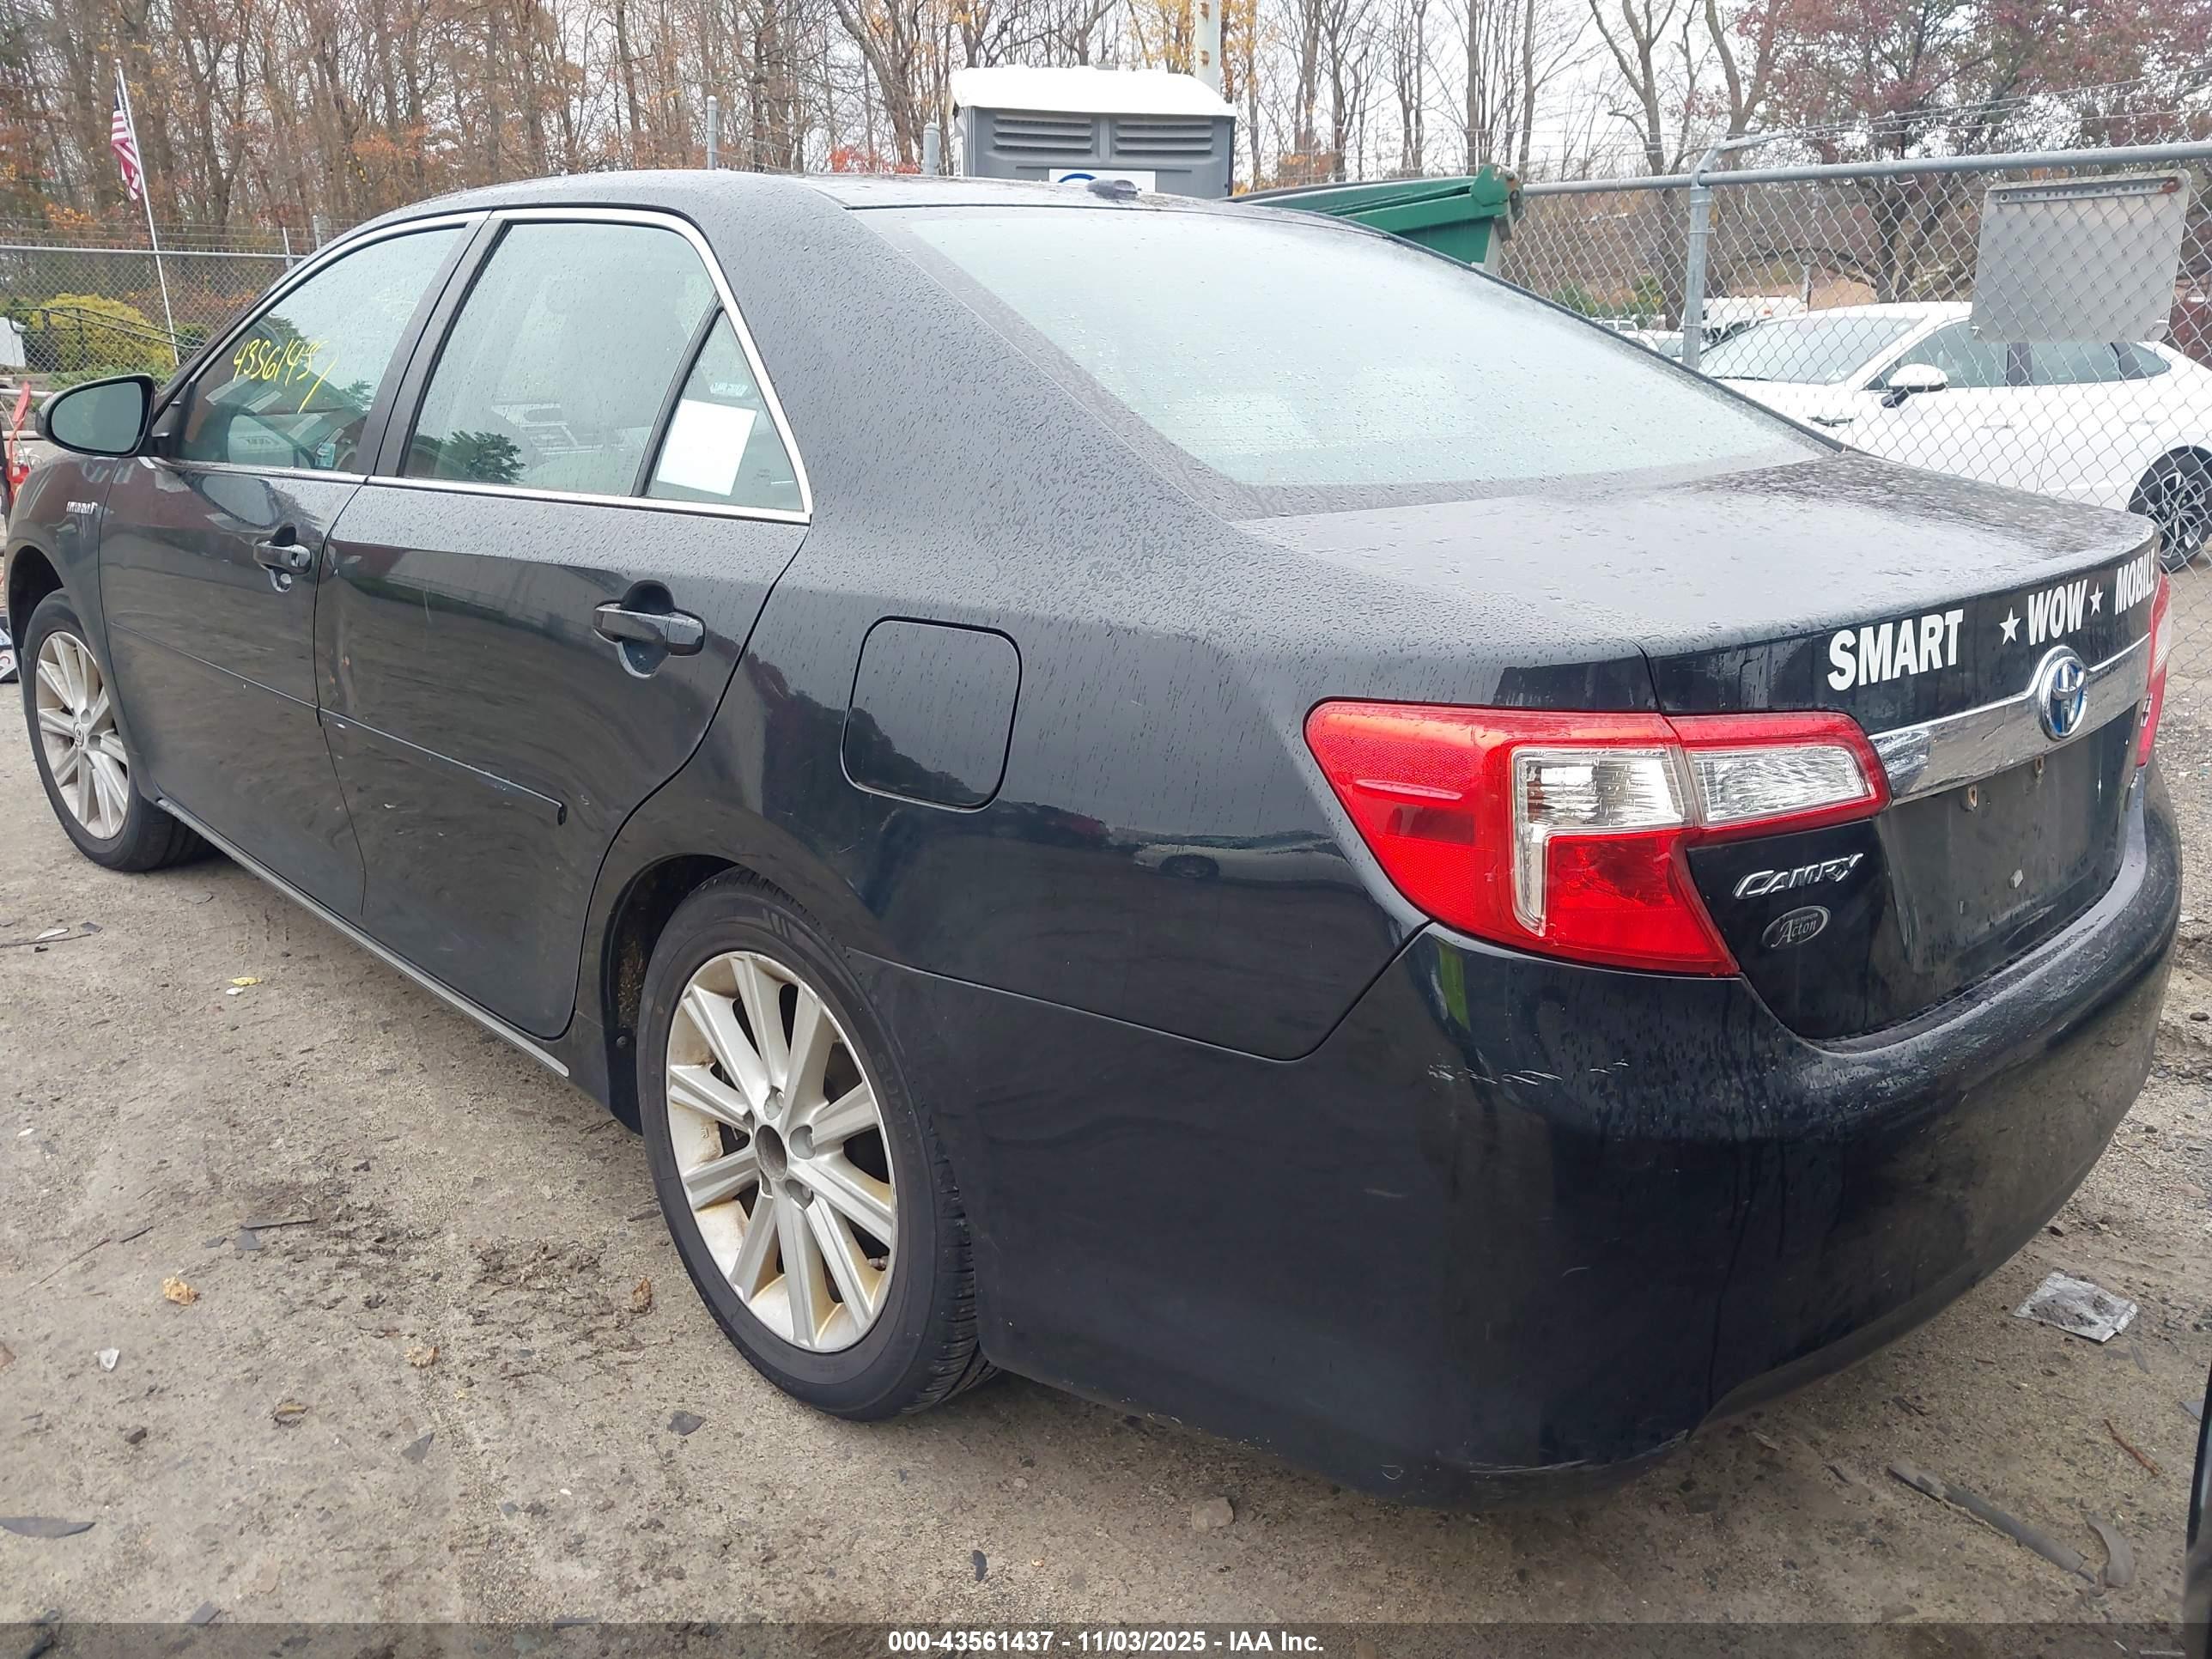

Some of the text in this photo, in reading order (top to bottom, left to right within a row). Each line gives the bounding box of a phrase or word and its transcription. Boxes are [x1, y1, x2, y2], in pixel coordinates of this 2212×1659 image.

[1827, 547, 2155, 691] SMART WOW MOBILE
[1732, 853, 1863, 899] CAMRY
[1771, 919, 1816, 948] Acton
